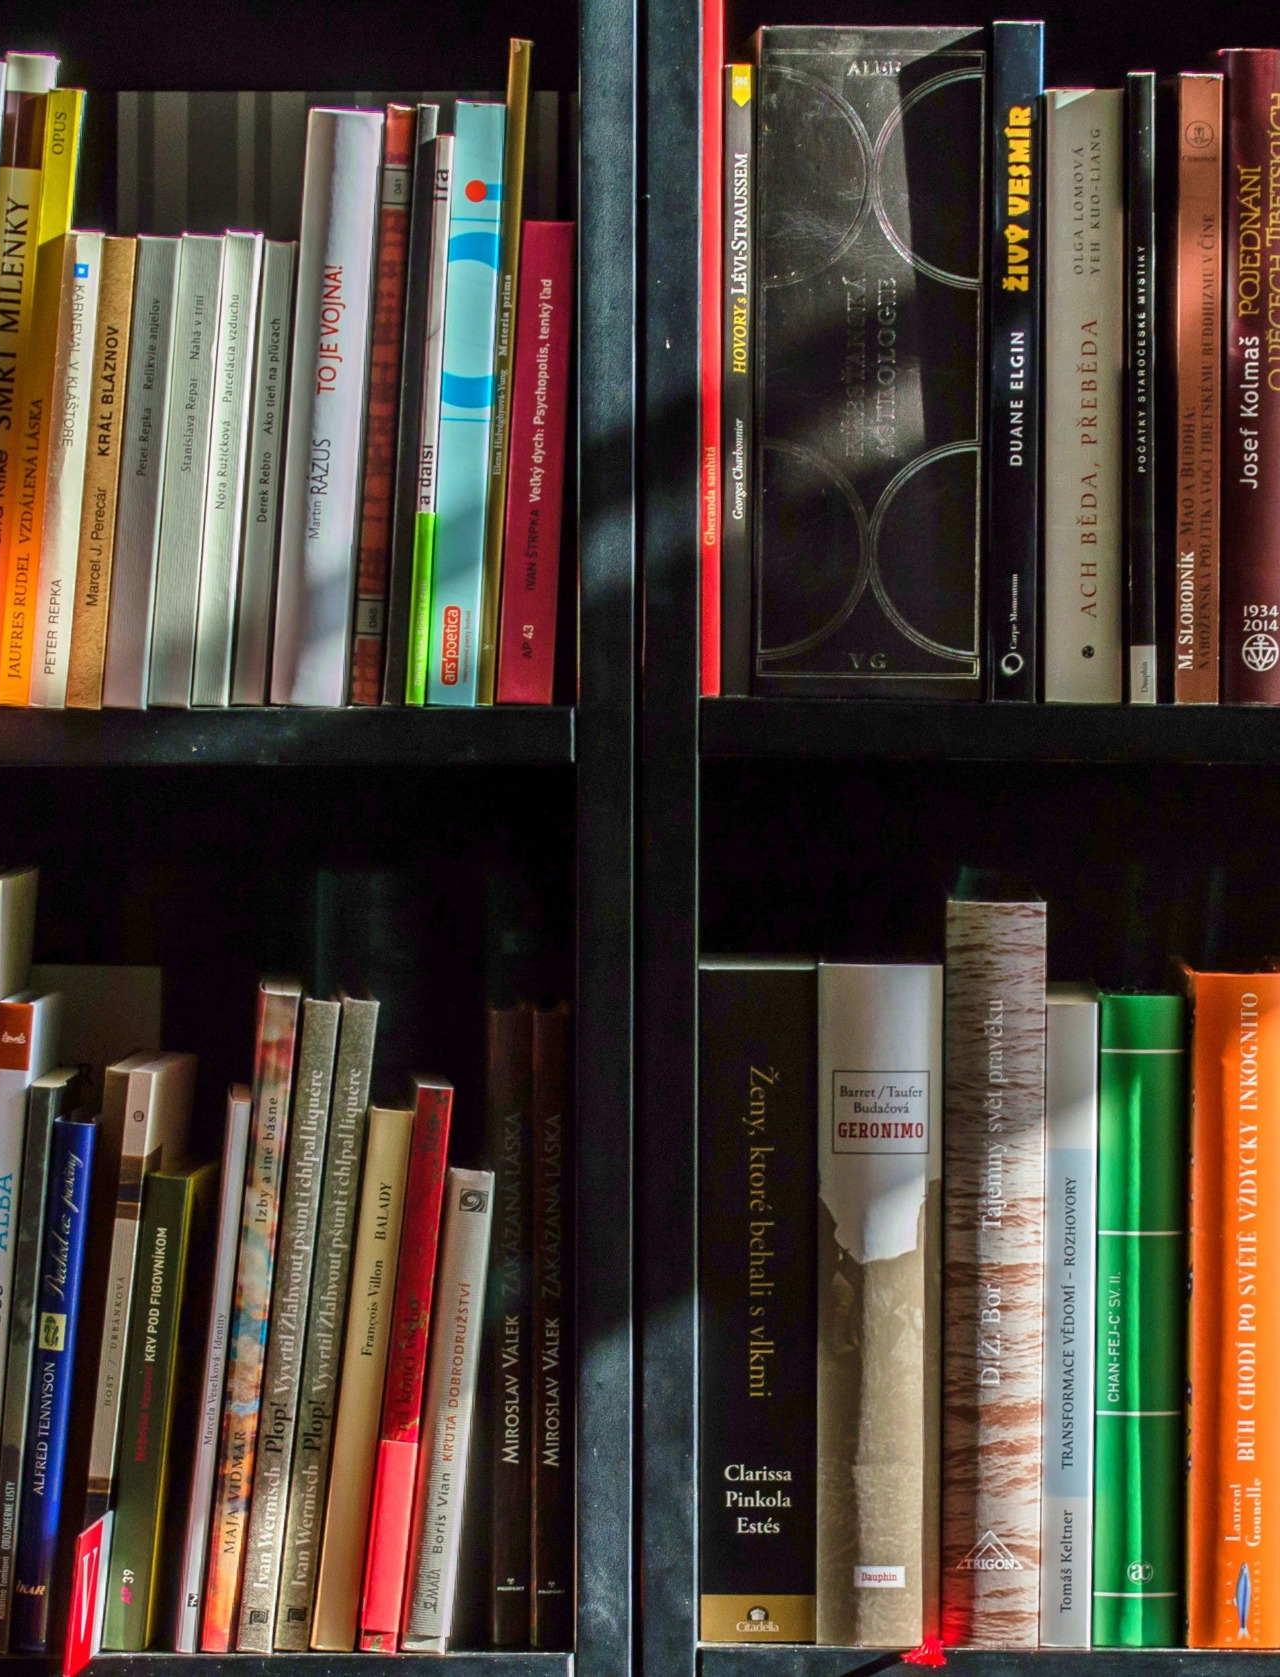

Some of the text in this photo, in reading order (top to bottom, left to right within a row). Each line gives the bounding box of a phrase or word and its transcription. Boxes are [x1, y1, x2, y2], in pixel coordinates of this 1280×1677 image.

[52, 112, 67, 155] OPUS
[1001, 106, 1032, 291] ŽIVÝ VESMÍR
[0, 196, 30, 333] MILENKY
[99, 326, 120, 405] BLÁZNOV
[317, 264, 345, 394] TO JE VOJNA!
[529, 279, 553, 502] Veľký dych: Psychopolis, tenký ľad
[1009, 332, 1025, 466] DUANE ELGIN
[1239, 336, 1260, 489] Josef Kolmaš
[306, 439, 331, 539] Martin RÁZUS
[1075, 319, 1100, 618] ACH BĚDA, PŘEBĚDA
[1243, 620, 1279, 632] 2014
[1244, 604, 1279, 617] 1934
[837, 1122, 925, 1139] GERONIMO
[1235, 993, 1258, 1461] BŮH CHODÍ PO SVĚTĚ VŽDYCKY INKOGNITO
[145, 1227, 167, 1362] KRV POD FIGOVNÍKOM
[500, 1315, 520, 1464] MIROSLAV VÁLEK
[724, 1464, 792, 1482] Clarissa
[725, 1491, 792, 1508] Pinkola
[1225, 1484, 1241, 1541] Laurent
[1245, 1478, 1262, 1547] Gounelle
[735, 1520, 781, 1535] Estés
[1060, 1509, 1073, 1612] Tomáš Keltner
